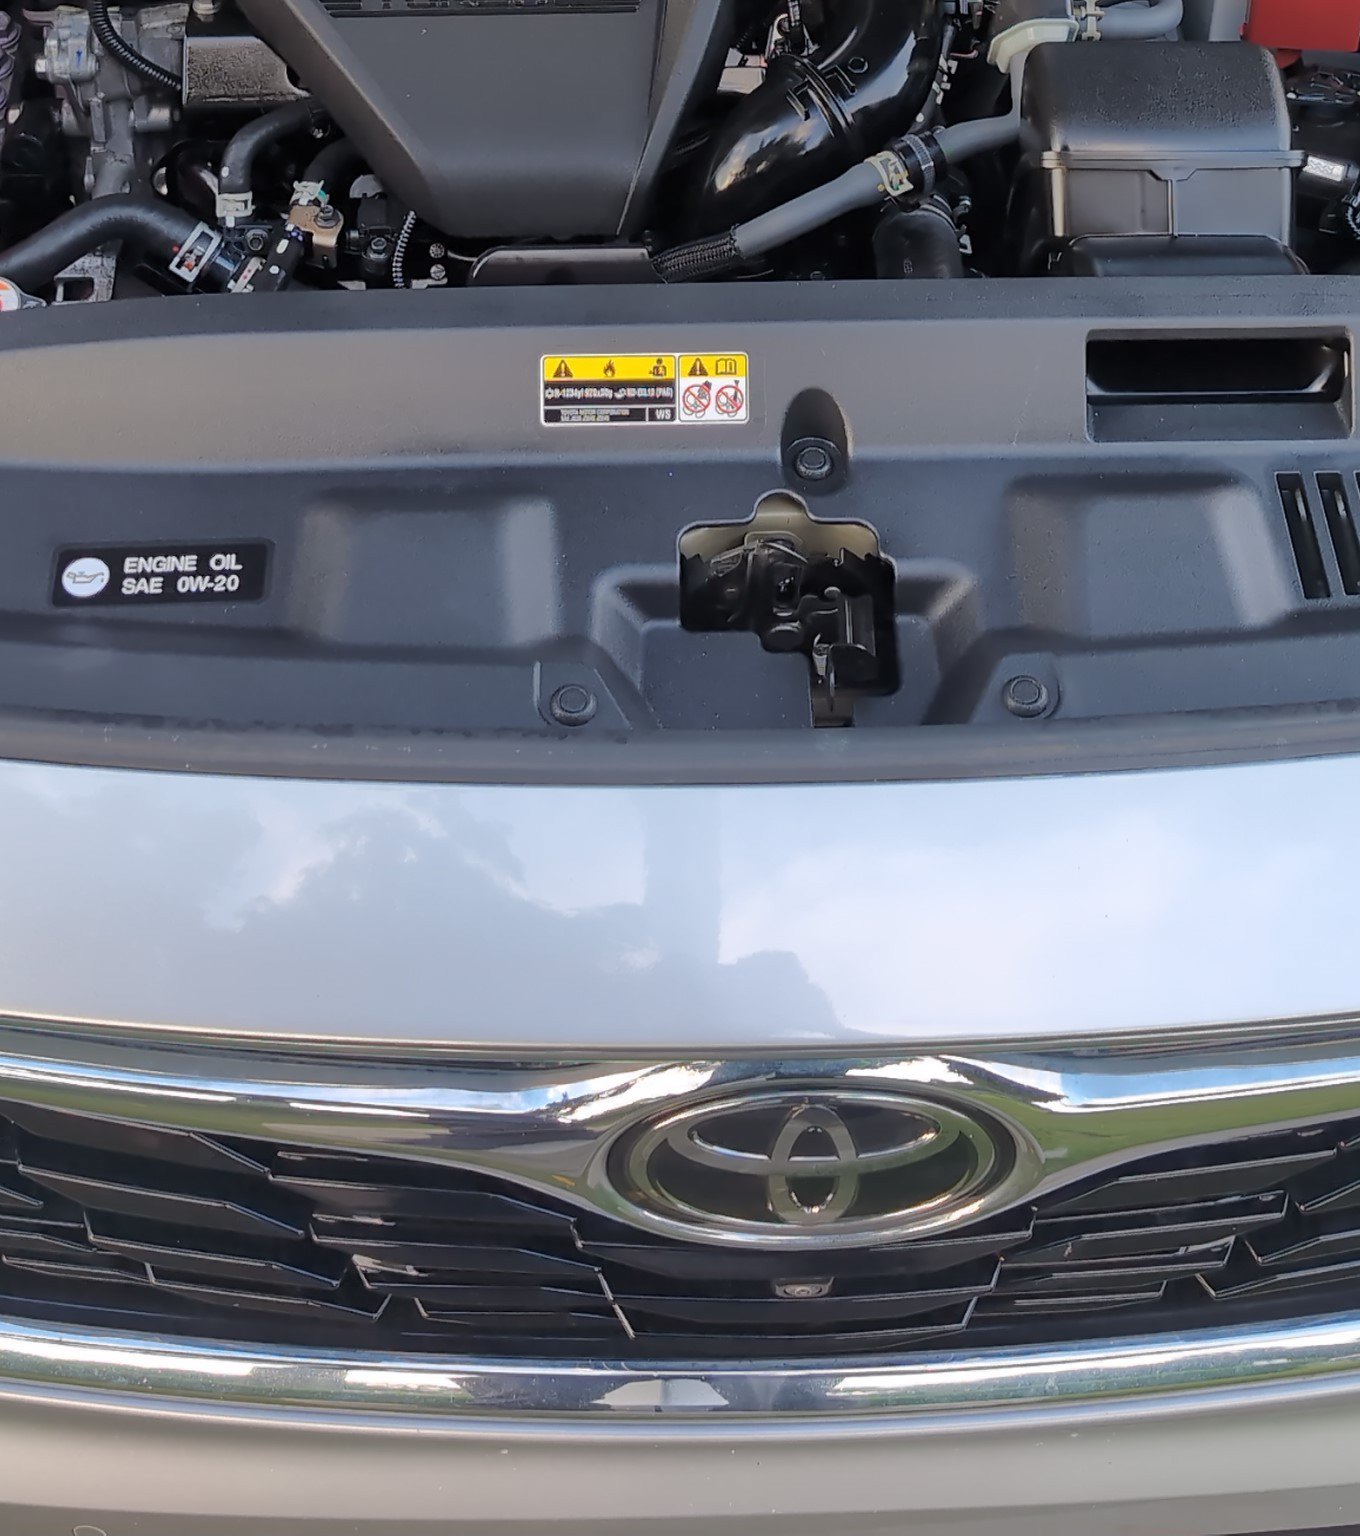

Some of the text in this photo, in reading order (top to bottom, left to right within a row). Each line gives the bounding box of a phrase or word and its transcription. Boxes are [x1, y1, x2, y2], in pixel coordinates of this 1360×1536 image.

[124, 554, 243, 574] ENGINE OIL
[122, 575, 240, 595] SAE 0W-20
